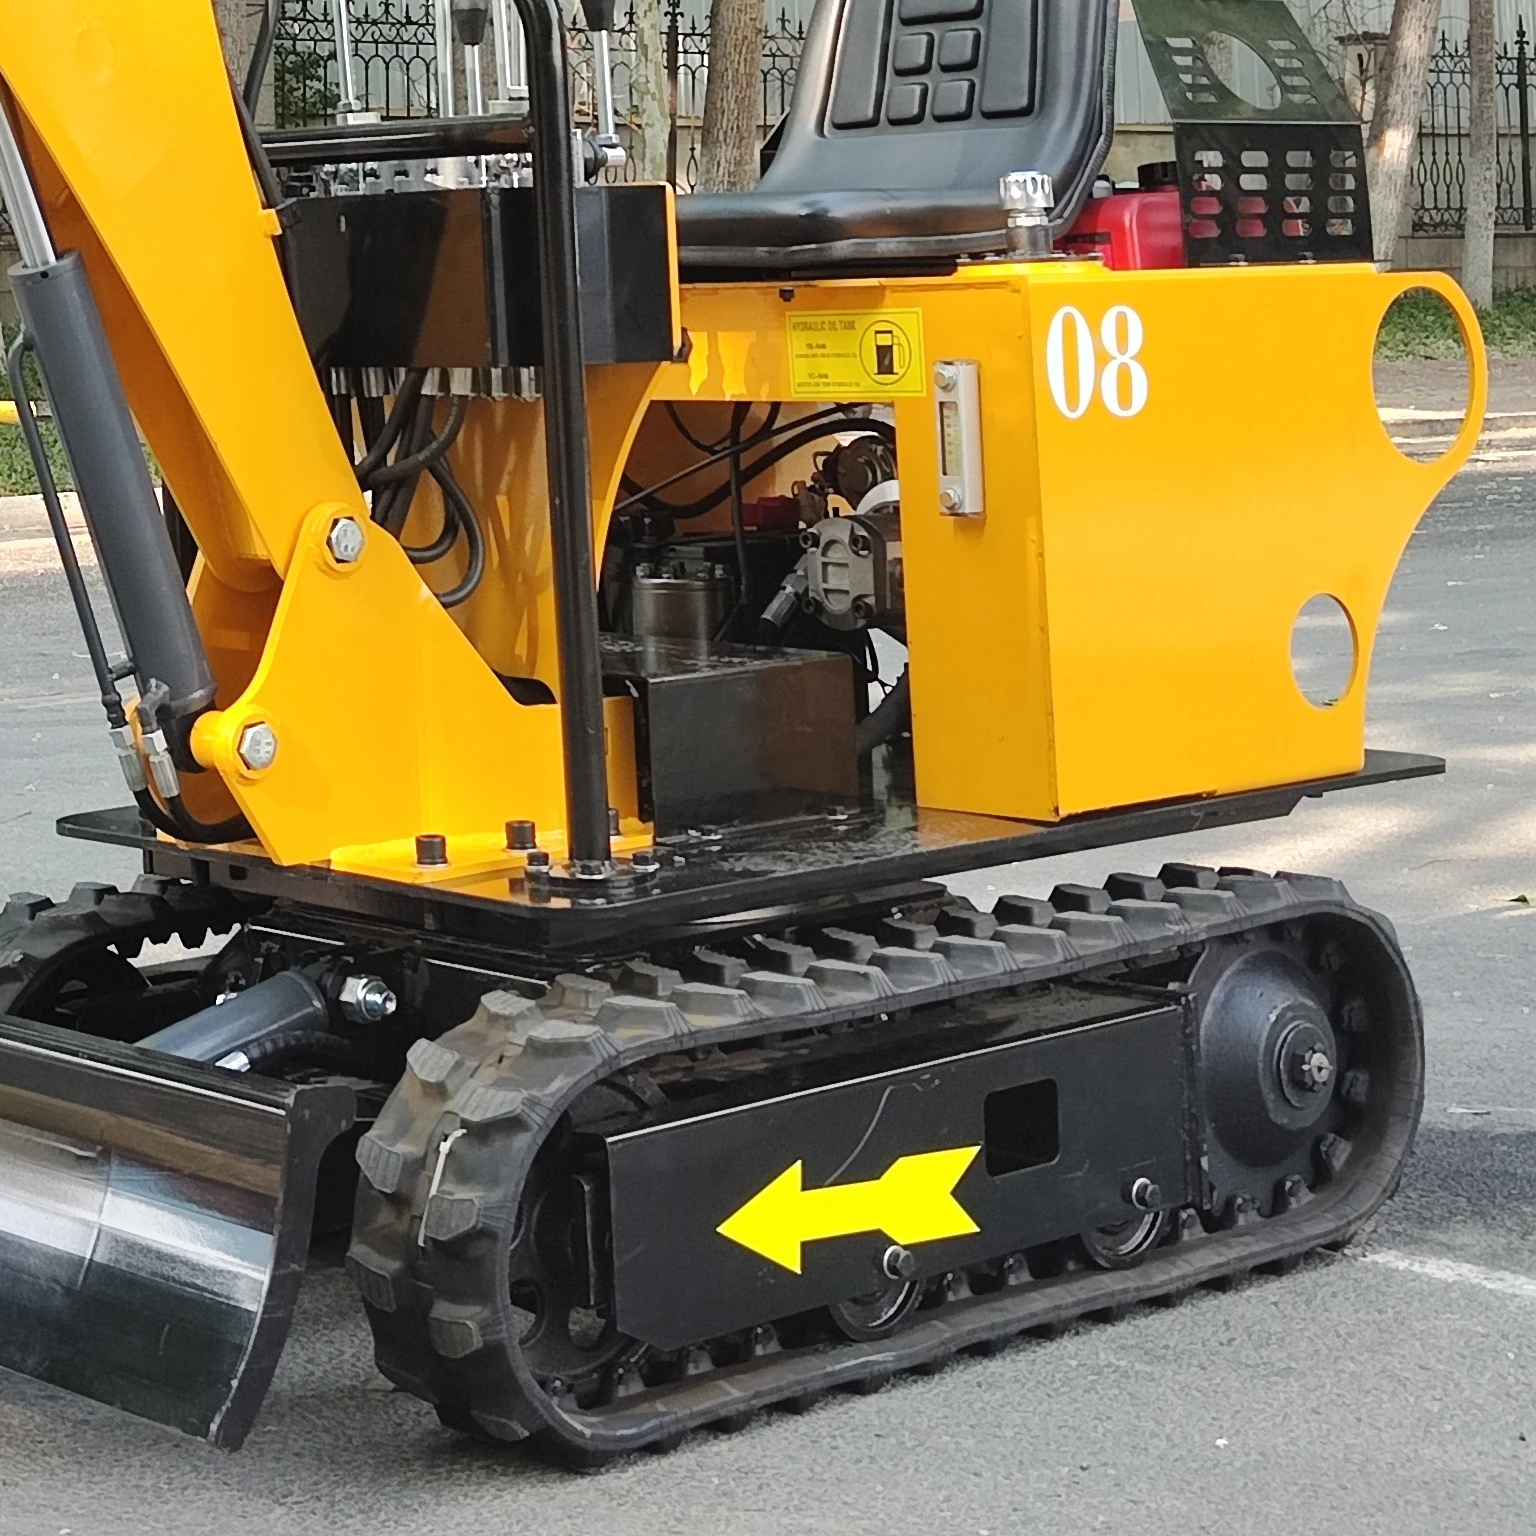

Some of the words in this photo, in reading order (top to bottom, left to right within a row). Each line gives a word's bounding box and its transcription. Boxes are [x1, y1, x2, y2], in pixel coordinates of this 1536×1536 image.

[792, 320, 827, 332] HYDRAULIC
[827, 319, 838, 331] OIL
[1046, 305, 1149, 420] 08
